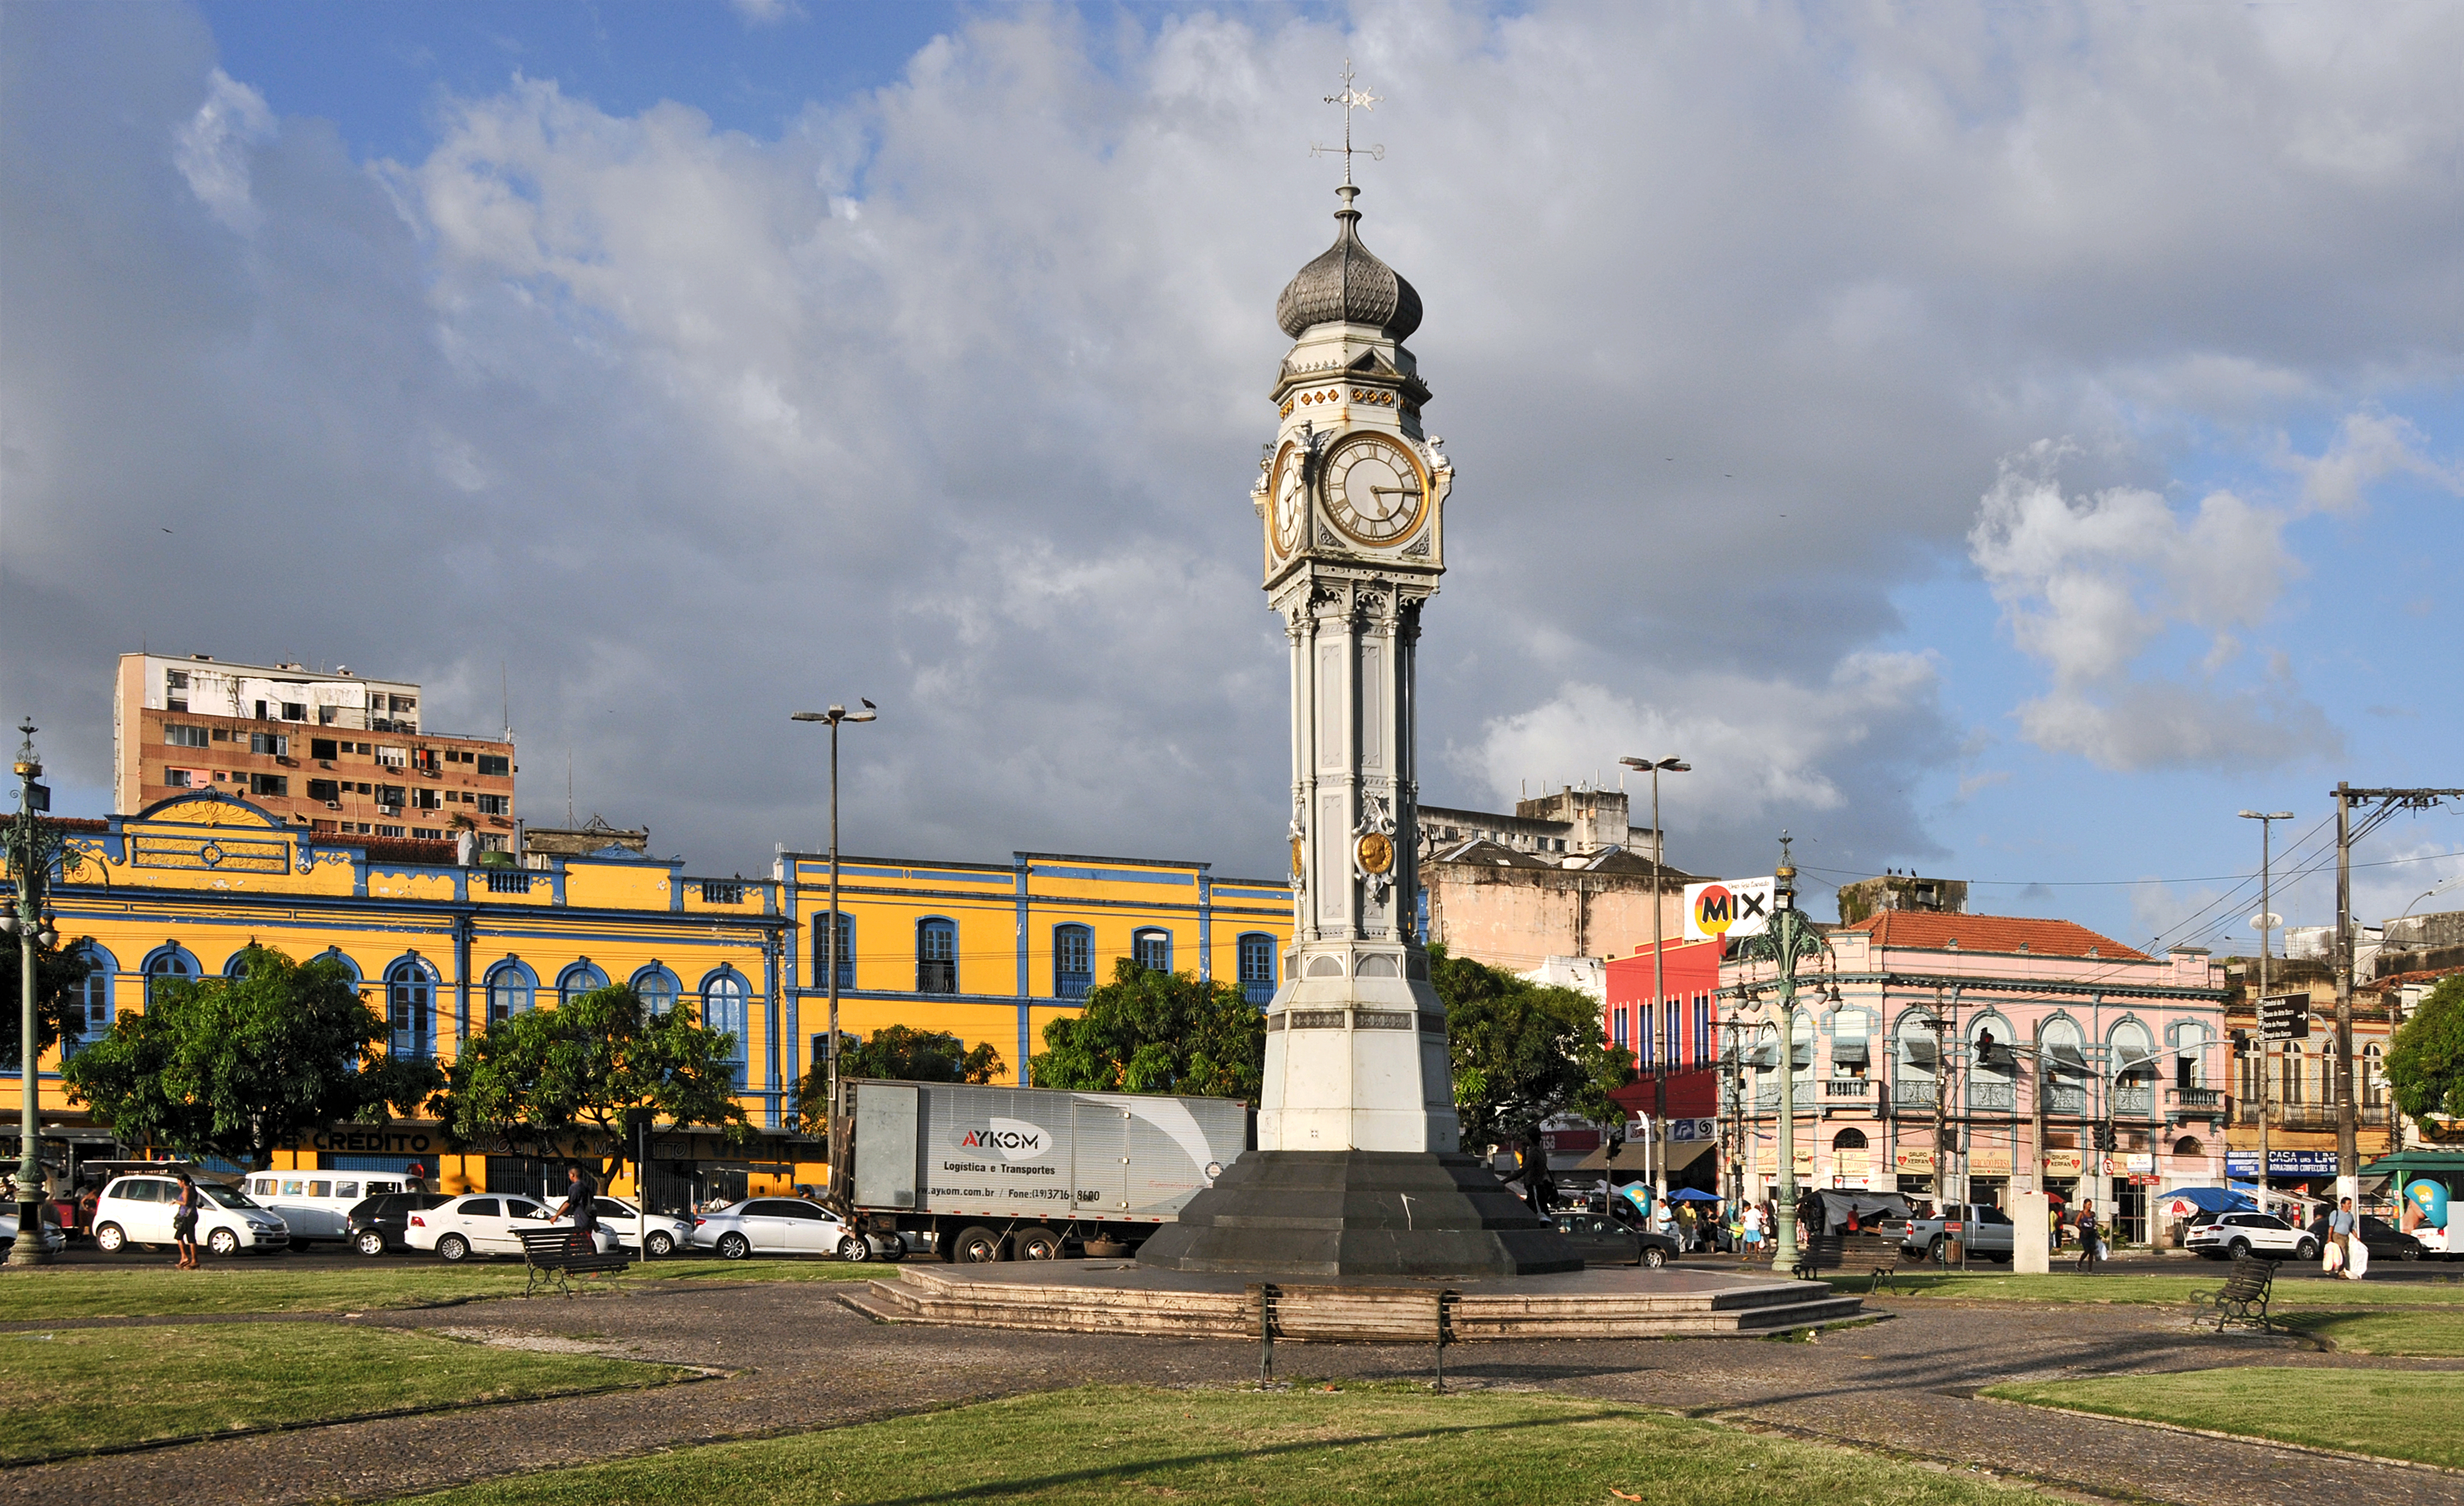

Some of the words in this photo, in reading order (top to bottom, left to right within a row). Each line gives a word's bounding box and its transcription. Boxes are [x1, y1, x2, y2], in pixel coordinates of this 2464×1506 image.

[1701, 892, 1765, 923] MIX
[313, 1129, 430, 1153] CRÉDITO
[962, 1130, 1038, 1150] AYKOM
[1970, 1159, 1993, 1168] MERCADO
[1994, 1159, 2010, 1168] PERSA
[2269, 1151, 2298, 1162] CASA
[944, 1161, 985, 1173] Logística
[1000, 1164, 1055, 1176] Transportes
[2419, 1191, 2433, 1202] oi
